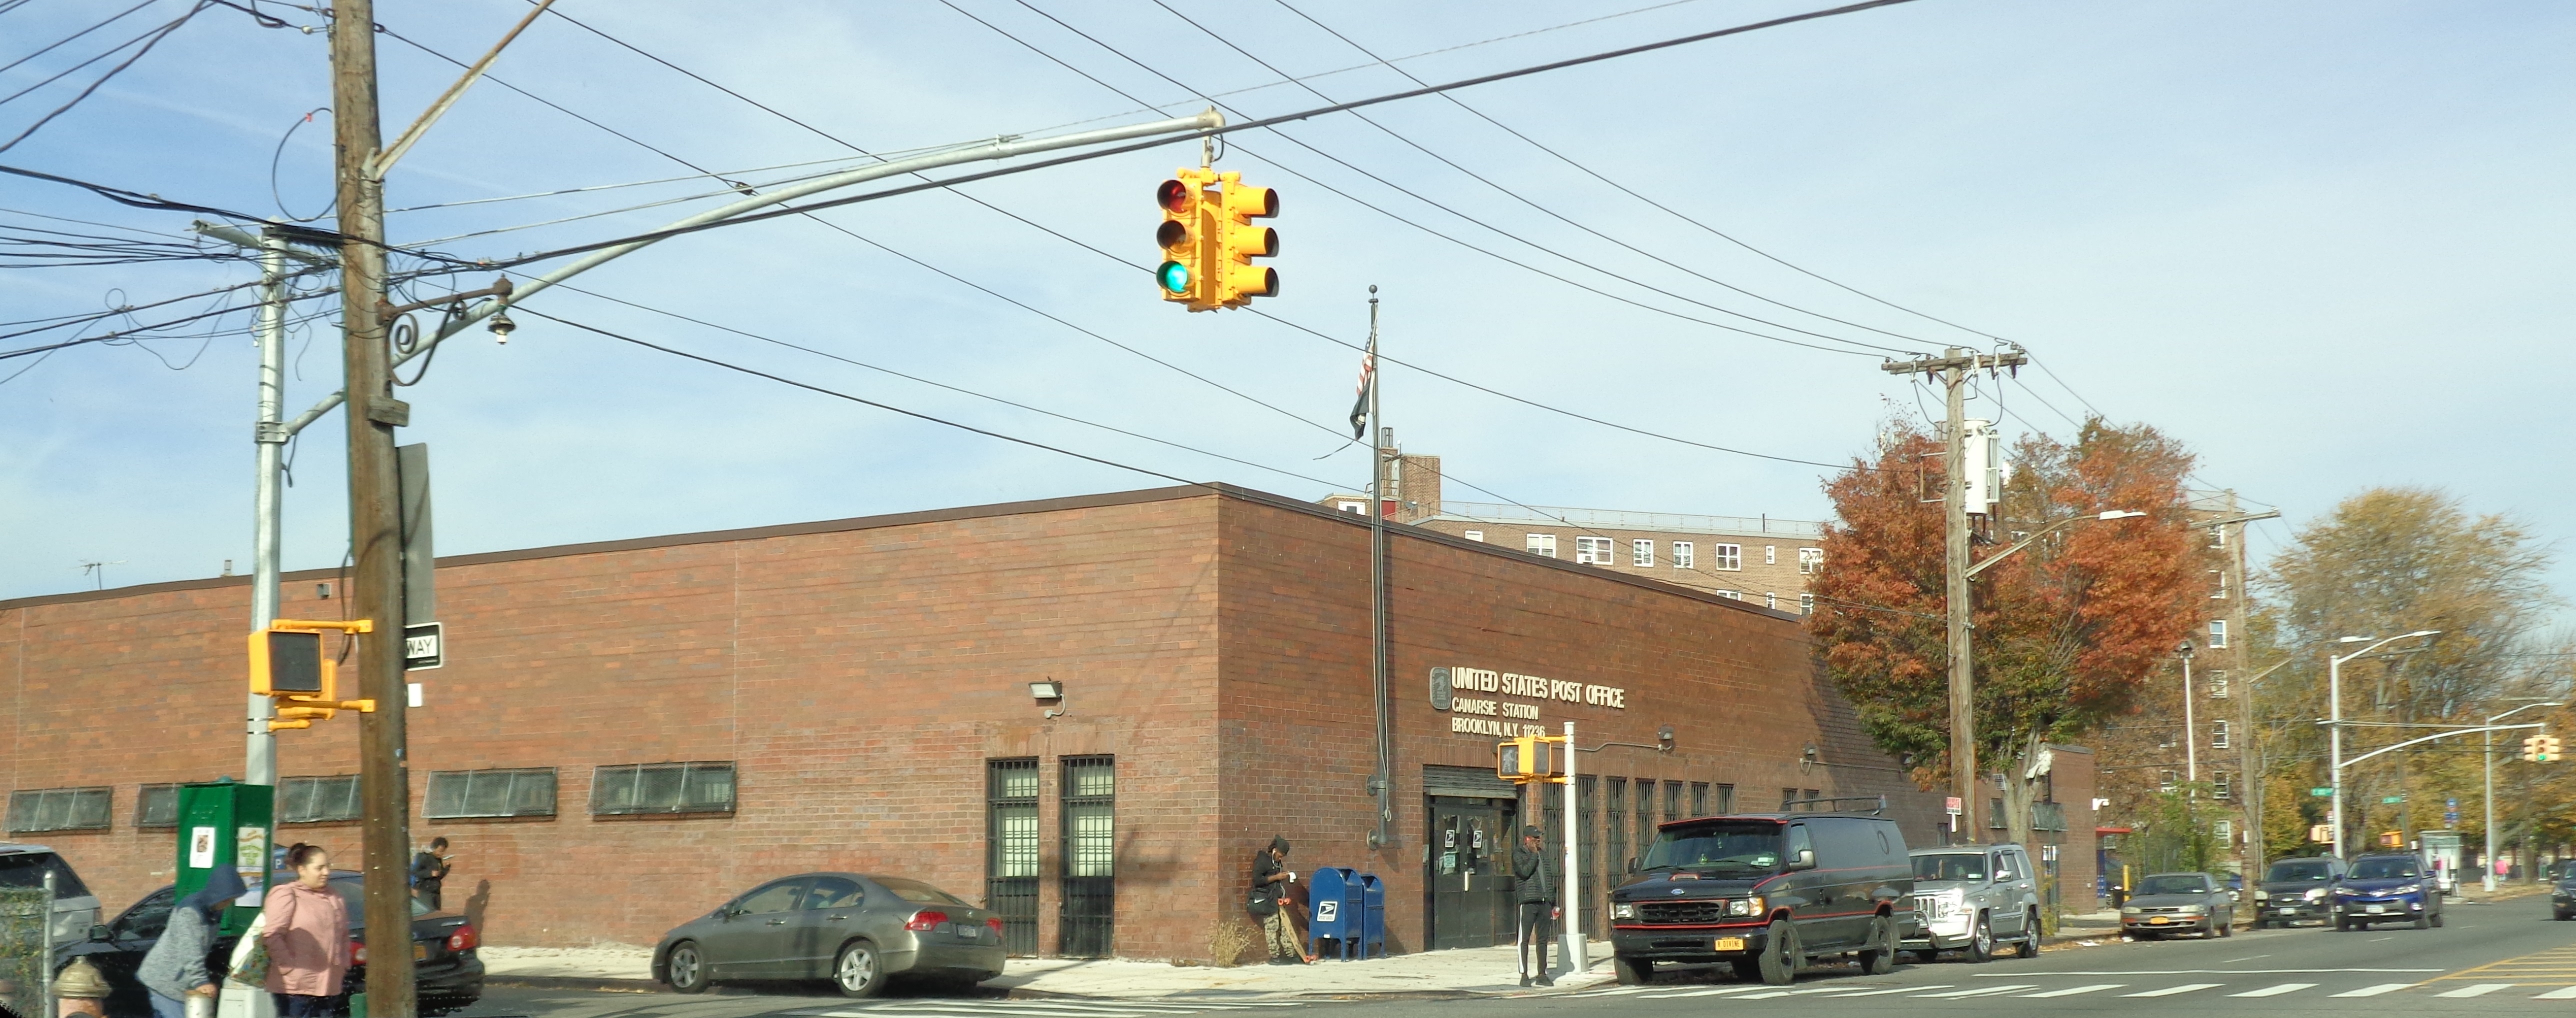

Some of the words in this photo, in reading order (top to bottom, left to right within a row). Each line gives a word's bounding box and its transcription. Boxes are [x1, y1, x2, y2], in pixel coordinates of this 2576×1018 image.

[406, 638, 432, 655] WAY
[1452, 666, 1498, 692] UNITED
[1502, 672, 1548, 699] STATES
[1551, 679, 1582, 703] POST
[1586, 684, 1624, 708] OFFICE
[1452, 696, 1497, 716] CANARSIE
[1502, 701, 1539, 720] STATION
[1452, 717, 1502, 738] BROOKLYN,
[1522, 723, 1546, 738] 11236
